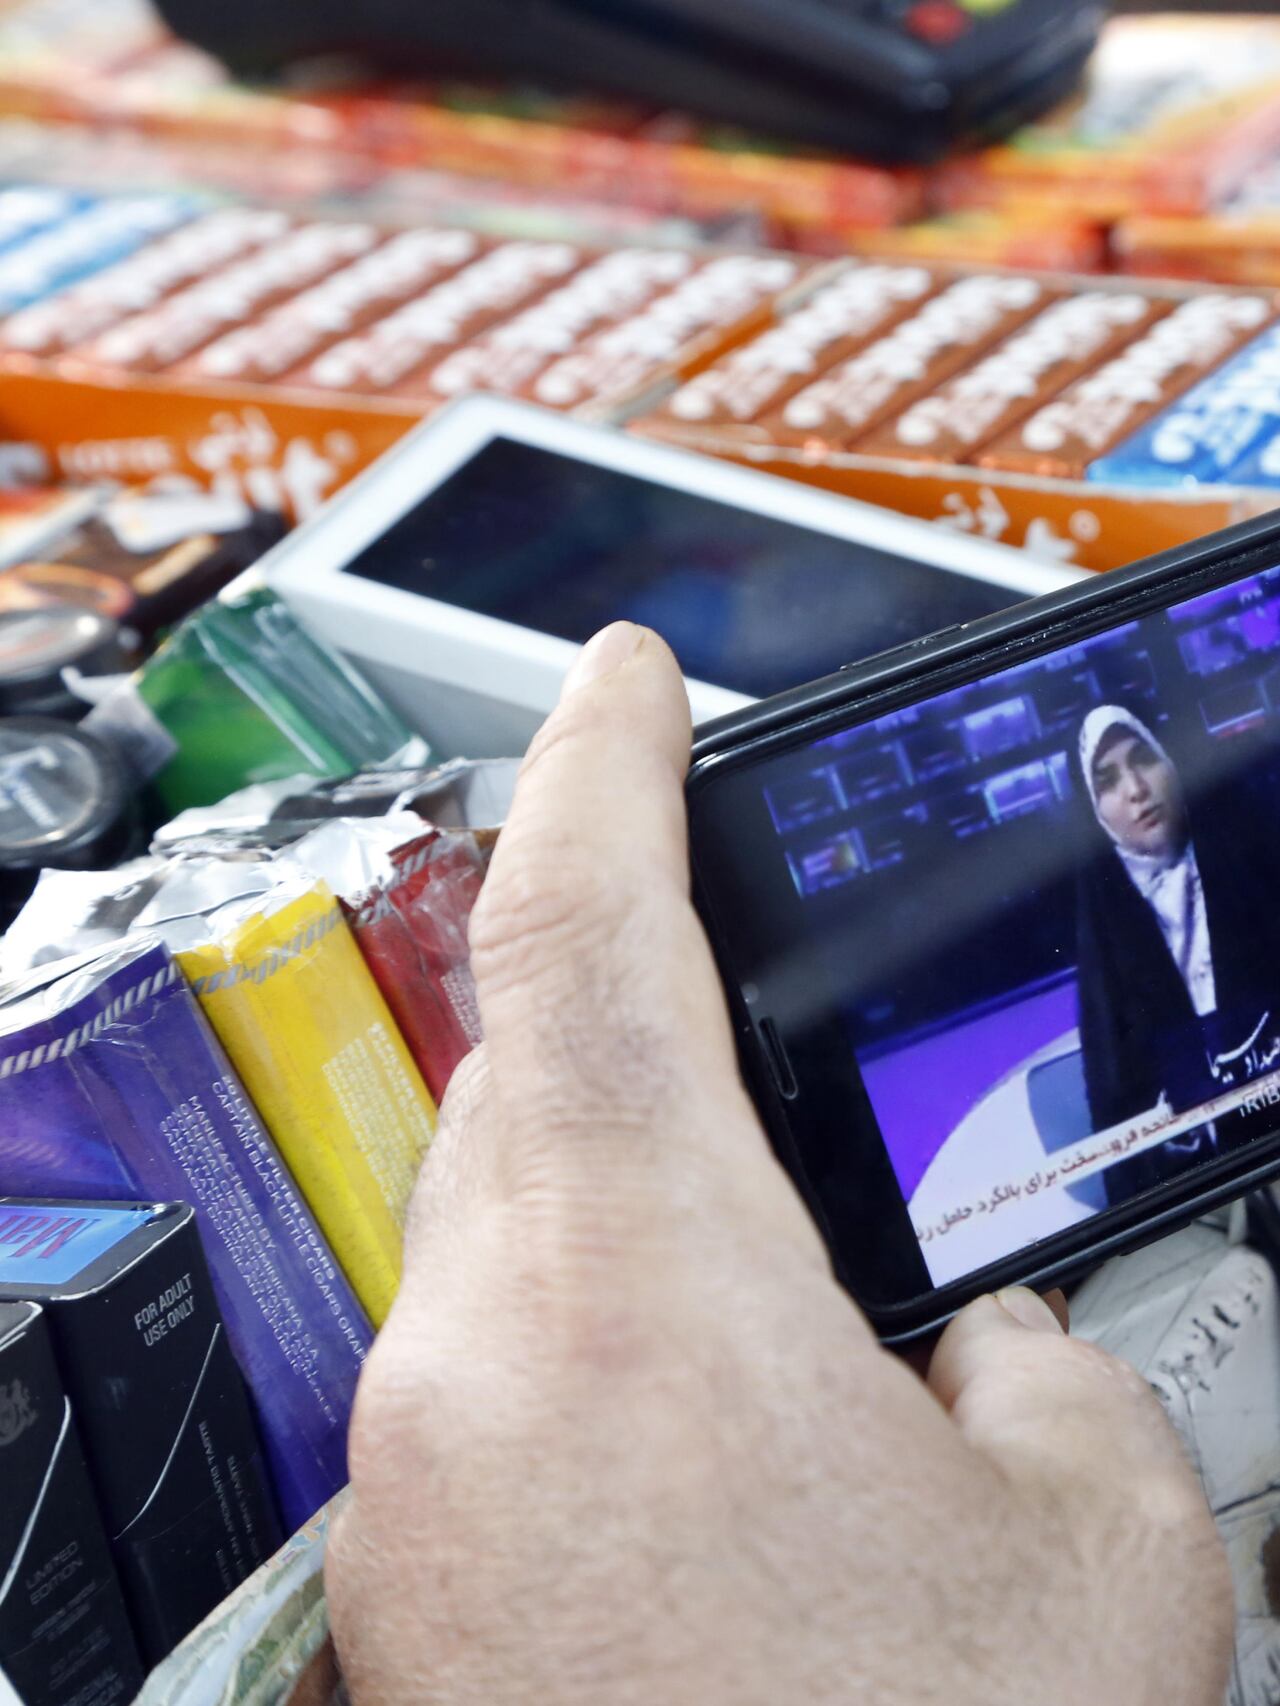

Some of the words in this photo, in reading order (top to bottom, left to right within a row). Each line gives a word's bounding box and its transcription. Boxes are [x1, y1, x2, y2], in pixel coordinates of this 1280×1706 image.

[177, 1102, 222, 1177] GENERAL
[218, 1178, 250, 1228] CIGAR
[187, 1094, 264, 1227] MANUFACTURED
[210, 1080, 253, 1149] CAPTAIN
[247, 1149, 282, 1203] BLACK
[276, 1203, 311, 1256] LITTLE
[304, 1255, 343, 1316] CIGARS
[336, 1315, 368, 1365] GRAP
[233, 1096, 269, 1153] LITTLE
[265, 1156, 301, 1215] FILTER
[296, 1215, 336, 1280] CIGARS
[134, 1302, 159, 1330] FOR
[159, 1273, 192, 1312] ADULT
[143, 1318, 168, 1346] USE
[167, 1295, 194, 1328] ONLY
[207, 1206, 258, 1296] DOMINICAN
[255, 1297, 301, 1375] REPUBLIC
[26, 1541, 78, 1589] LIMITED
[30, 1557, 83, 1605] EDITION
